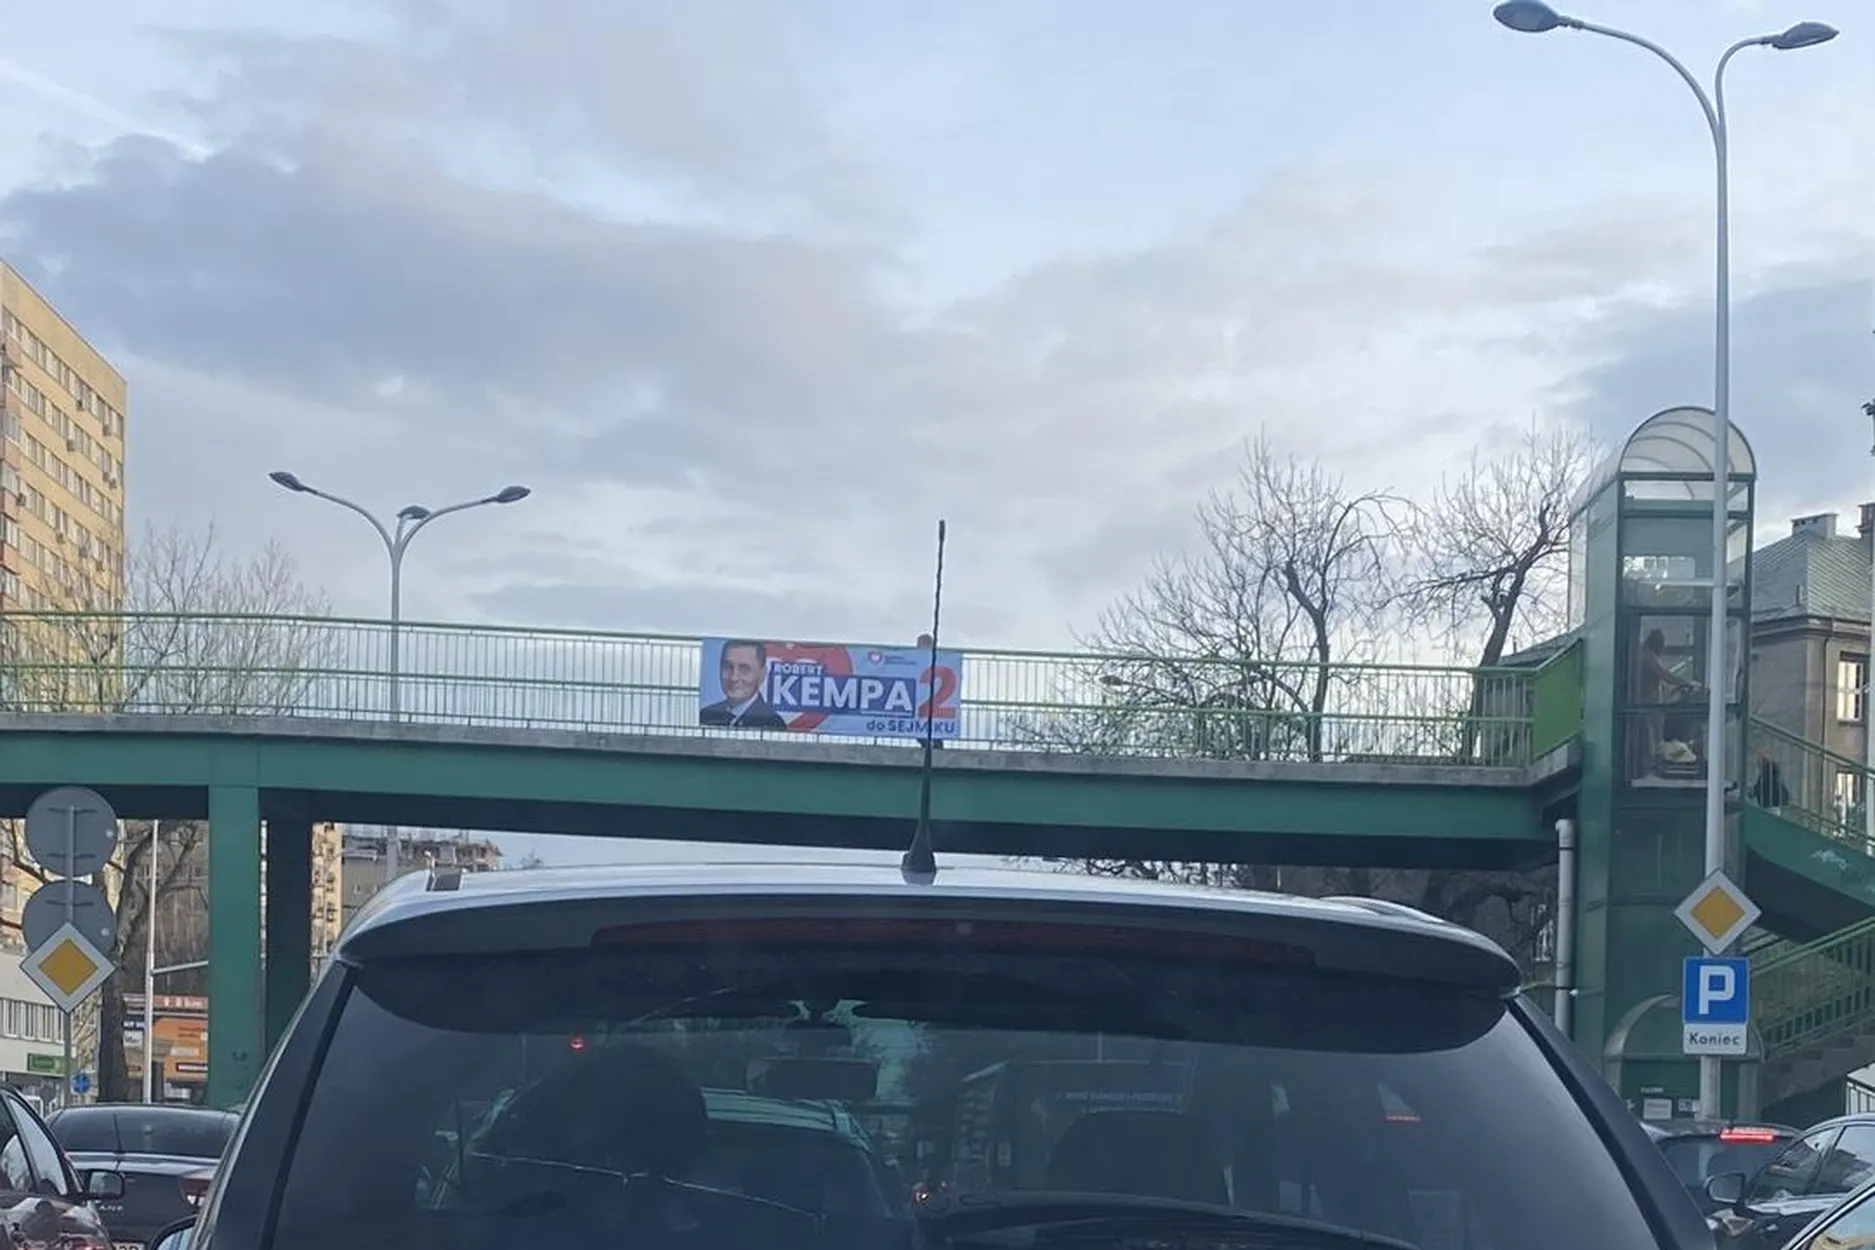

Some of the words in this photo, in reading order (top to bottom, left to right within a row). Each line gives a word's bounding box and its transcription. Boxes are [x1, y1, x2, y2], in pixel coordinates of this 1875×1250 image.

[774, 662, 823, 675] ROBERT
[772, 675, 913, 711] KEMPA
[918, 665, 957, 719] 2
[866, 719, 885, 732] do
[888, 719, 955, 734] SEJMKU
[1699, 964, 1735, 1015] P
[1689, 1032, 1740, 1045] Koniec
